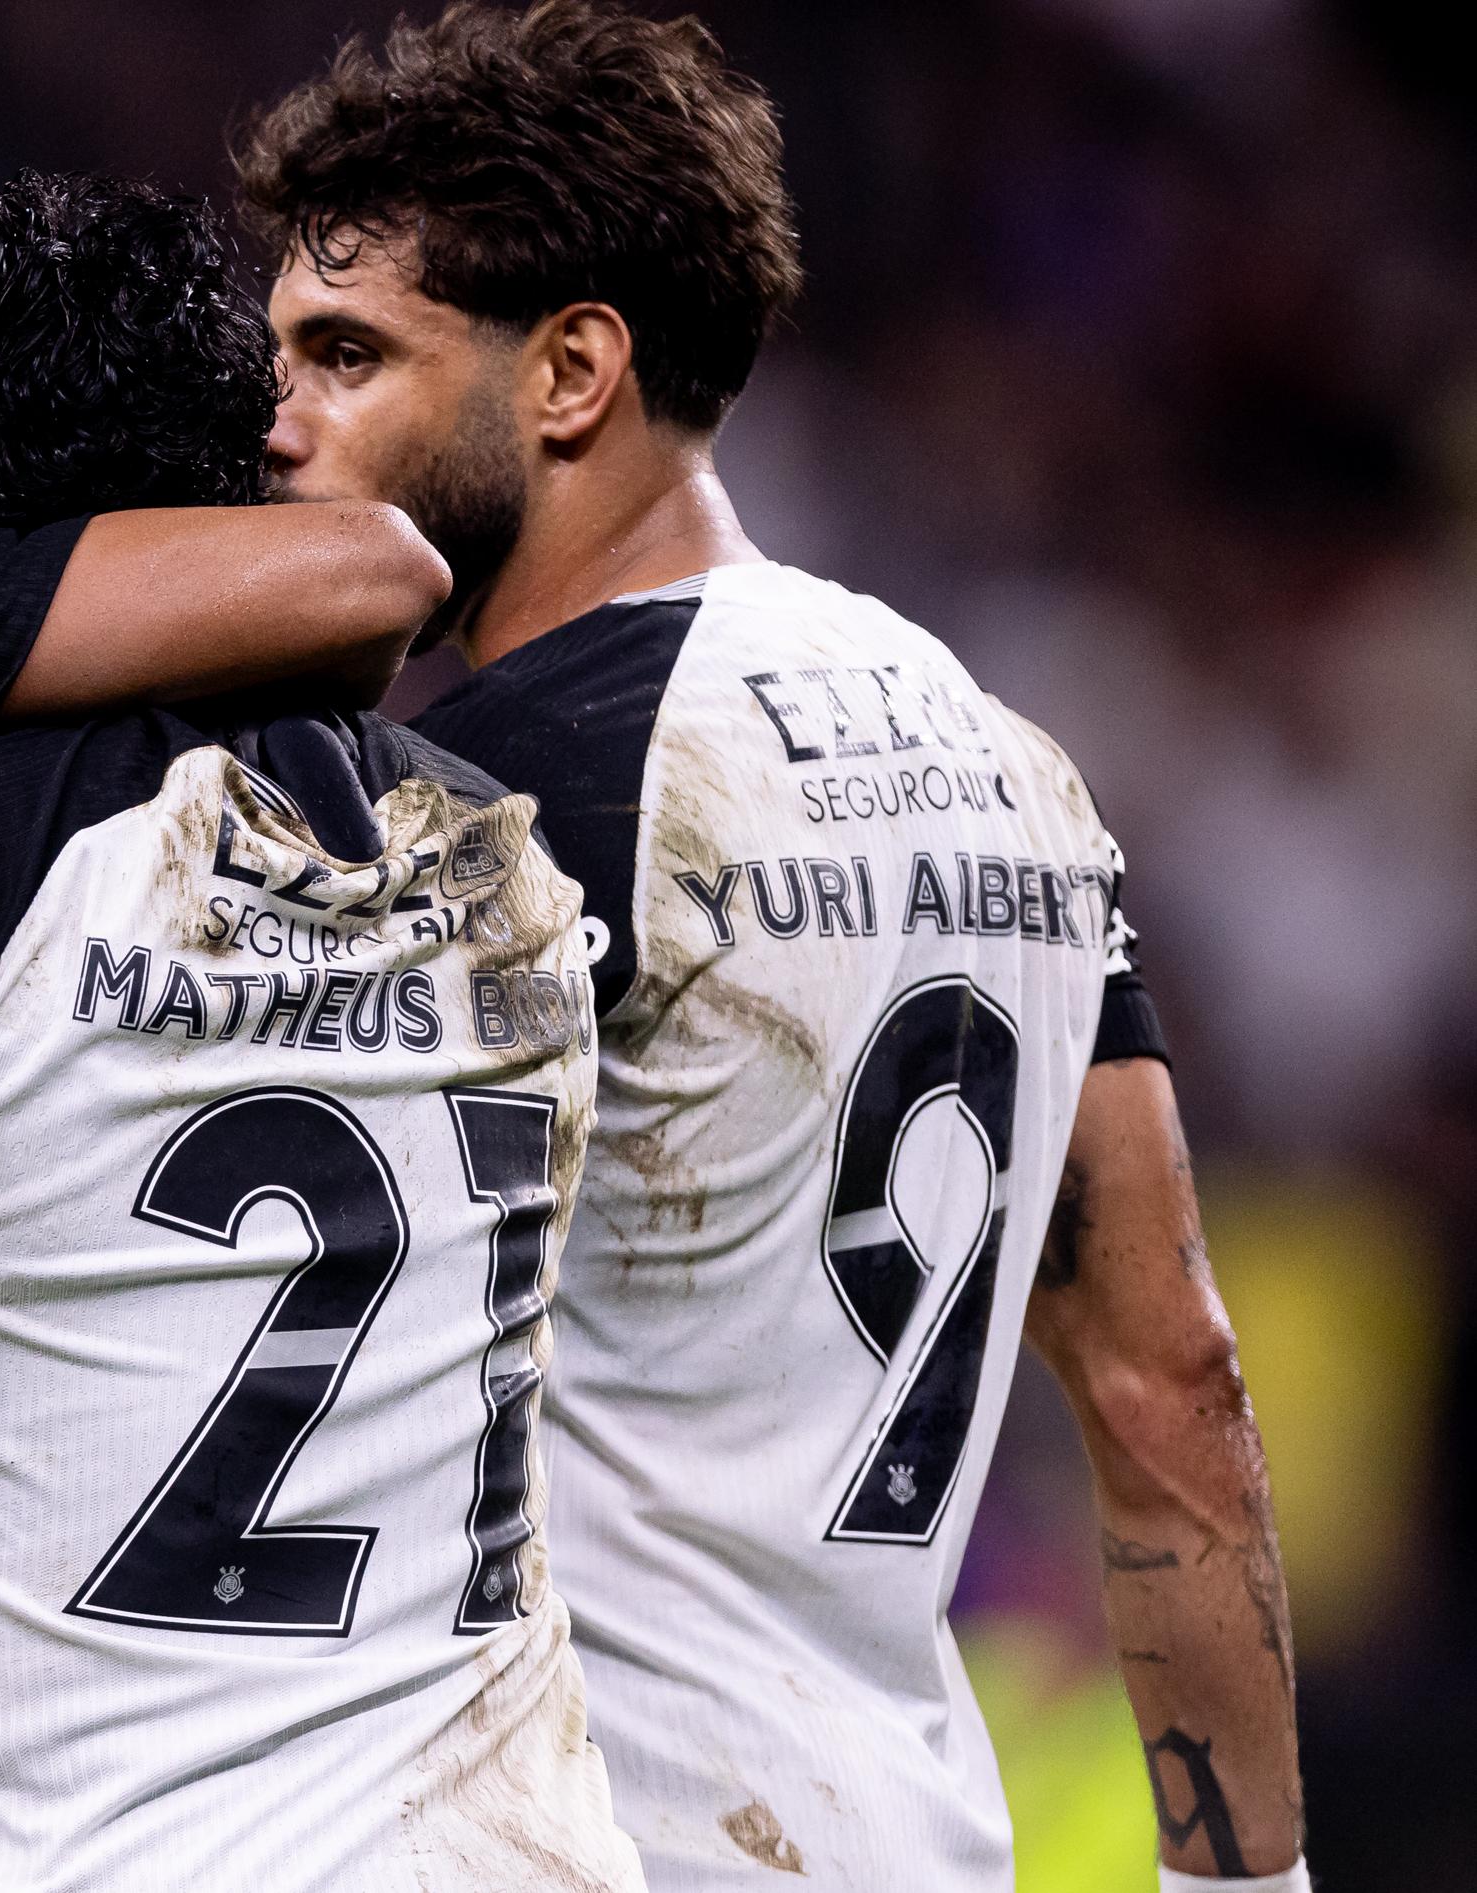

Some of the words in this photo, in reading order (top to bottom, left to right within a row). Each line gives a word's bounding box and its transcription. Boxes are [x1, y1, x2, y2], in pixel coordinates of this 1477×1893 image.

[801, 766, 952, 823] SEGURO
[673, 856, 878, 947] YURI
[72, 937, 443, 1054] MATHEUS
[822, 972, 1021, 1547] 9
[62, 1085, 558, 1638] 21
